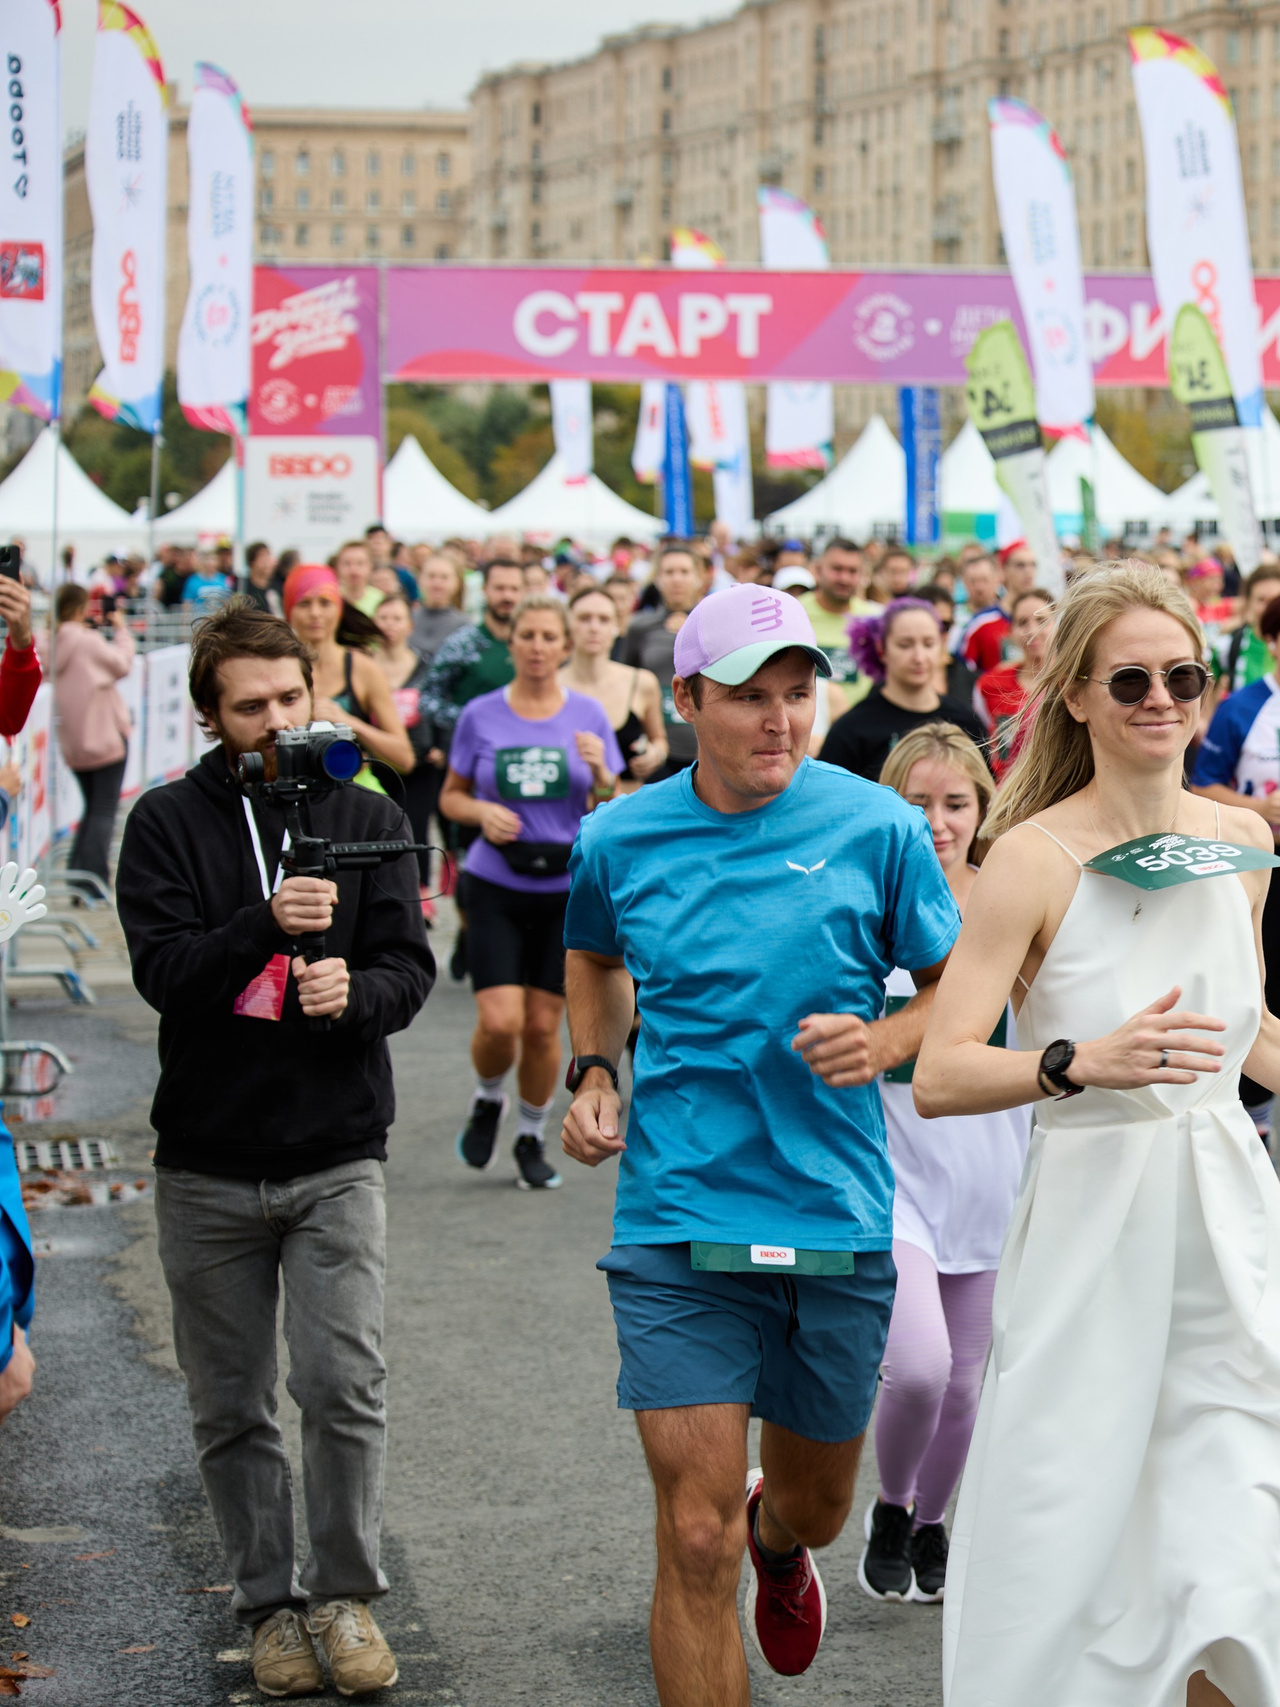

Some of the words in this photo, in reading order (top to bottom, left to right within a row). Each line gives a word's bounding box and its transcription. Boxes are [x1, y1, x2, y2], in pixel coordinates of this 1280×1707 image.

[512, 289, 773, 358] СТАРТ
[269, 453, 351, 478] BBDO
[1135, 844, 1242, 871] 5039
[760, 1250, 787, 1259] BBDO
